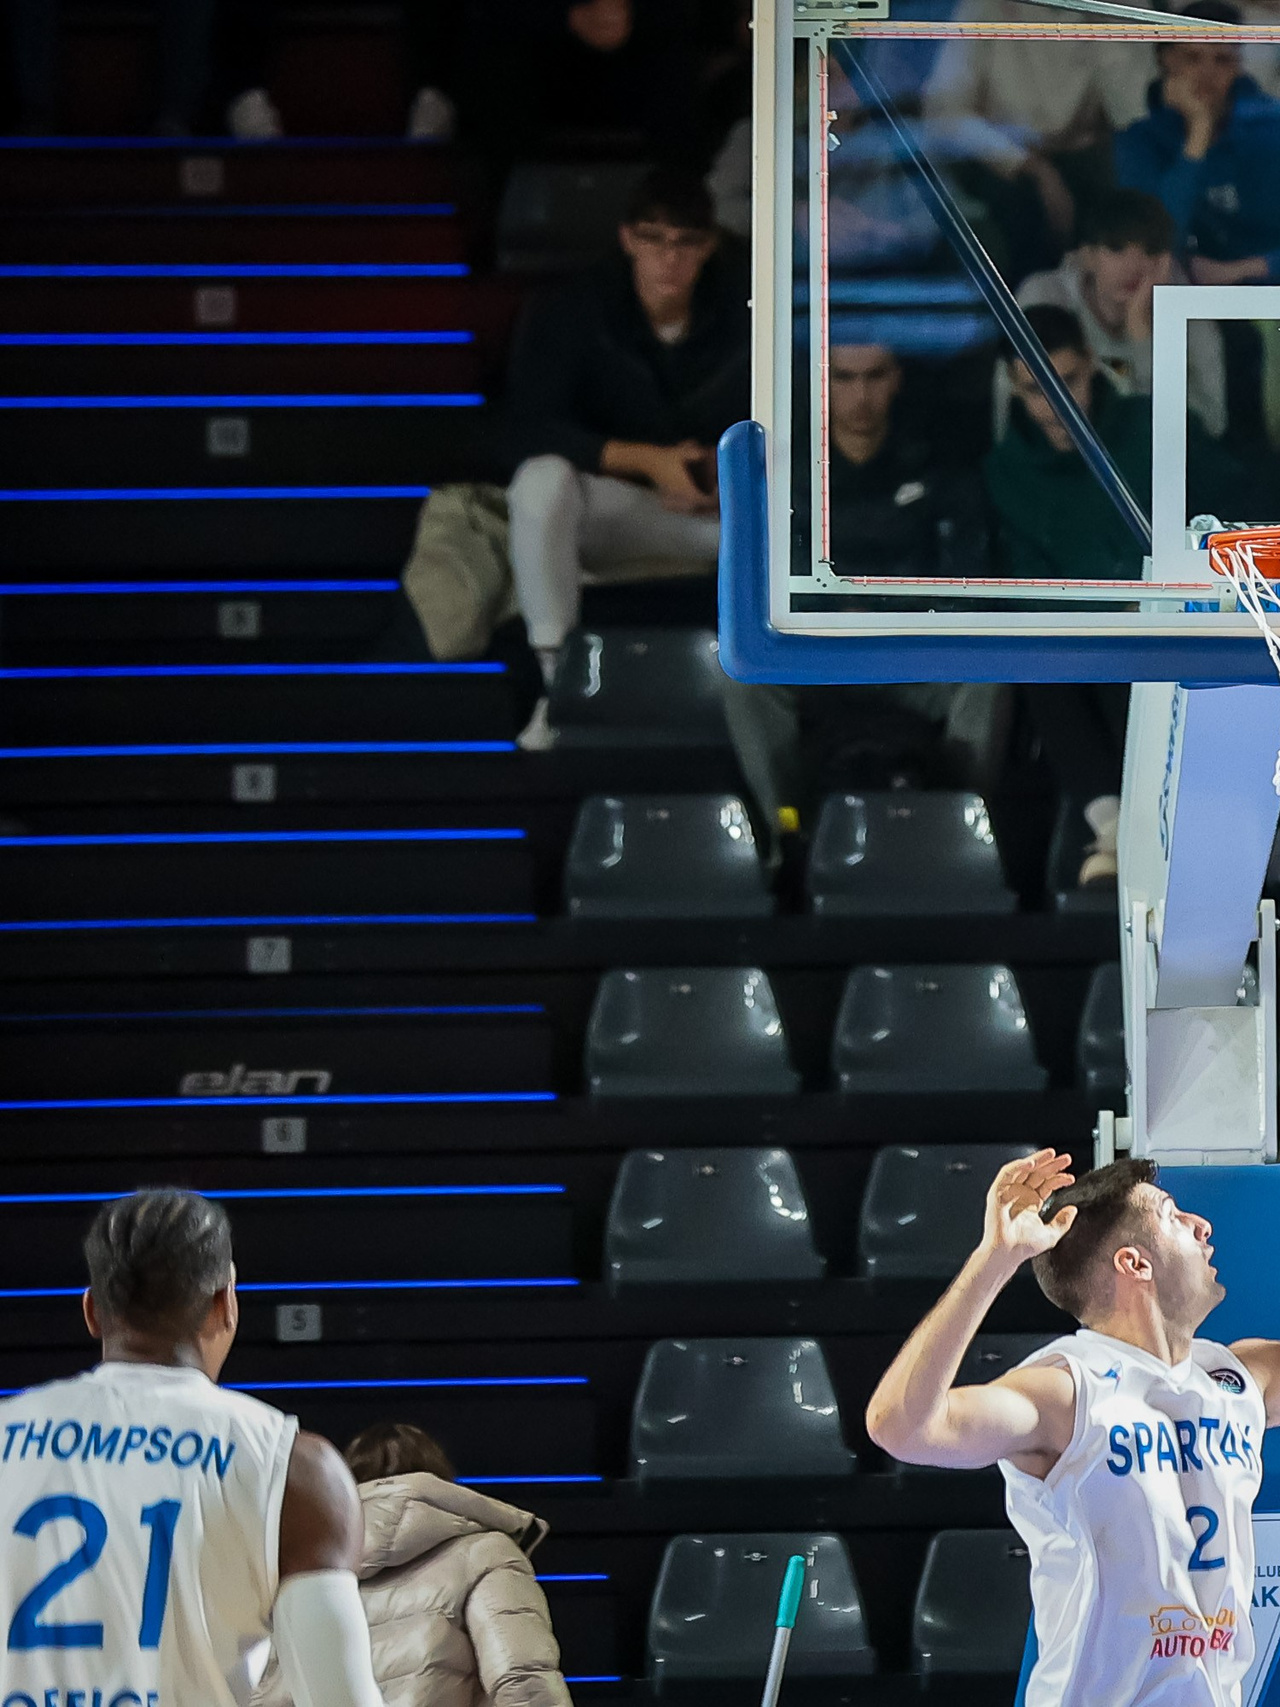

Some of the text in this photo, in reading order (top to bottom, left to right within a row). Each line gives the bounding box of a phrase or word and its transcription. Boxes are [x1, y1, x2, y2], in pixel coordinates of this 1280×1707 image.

[180, 1063, 332, 1095] elan
[292, 1308, 307, 1331] 5
[2, 1417, 236, 1483] THOMPSON
[1186, 1506, 1226, 1572] 2
[7, 1495, 181, 1650] 21
[1150, 1635, 1206, 1660] AUTO
